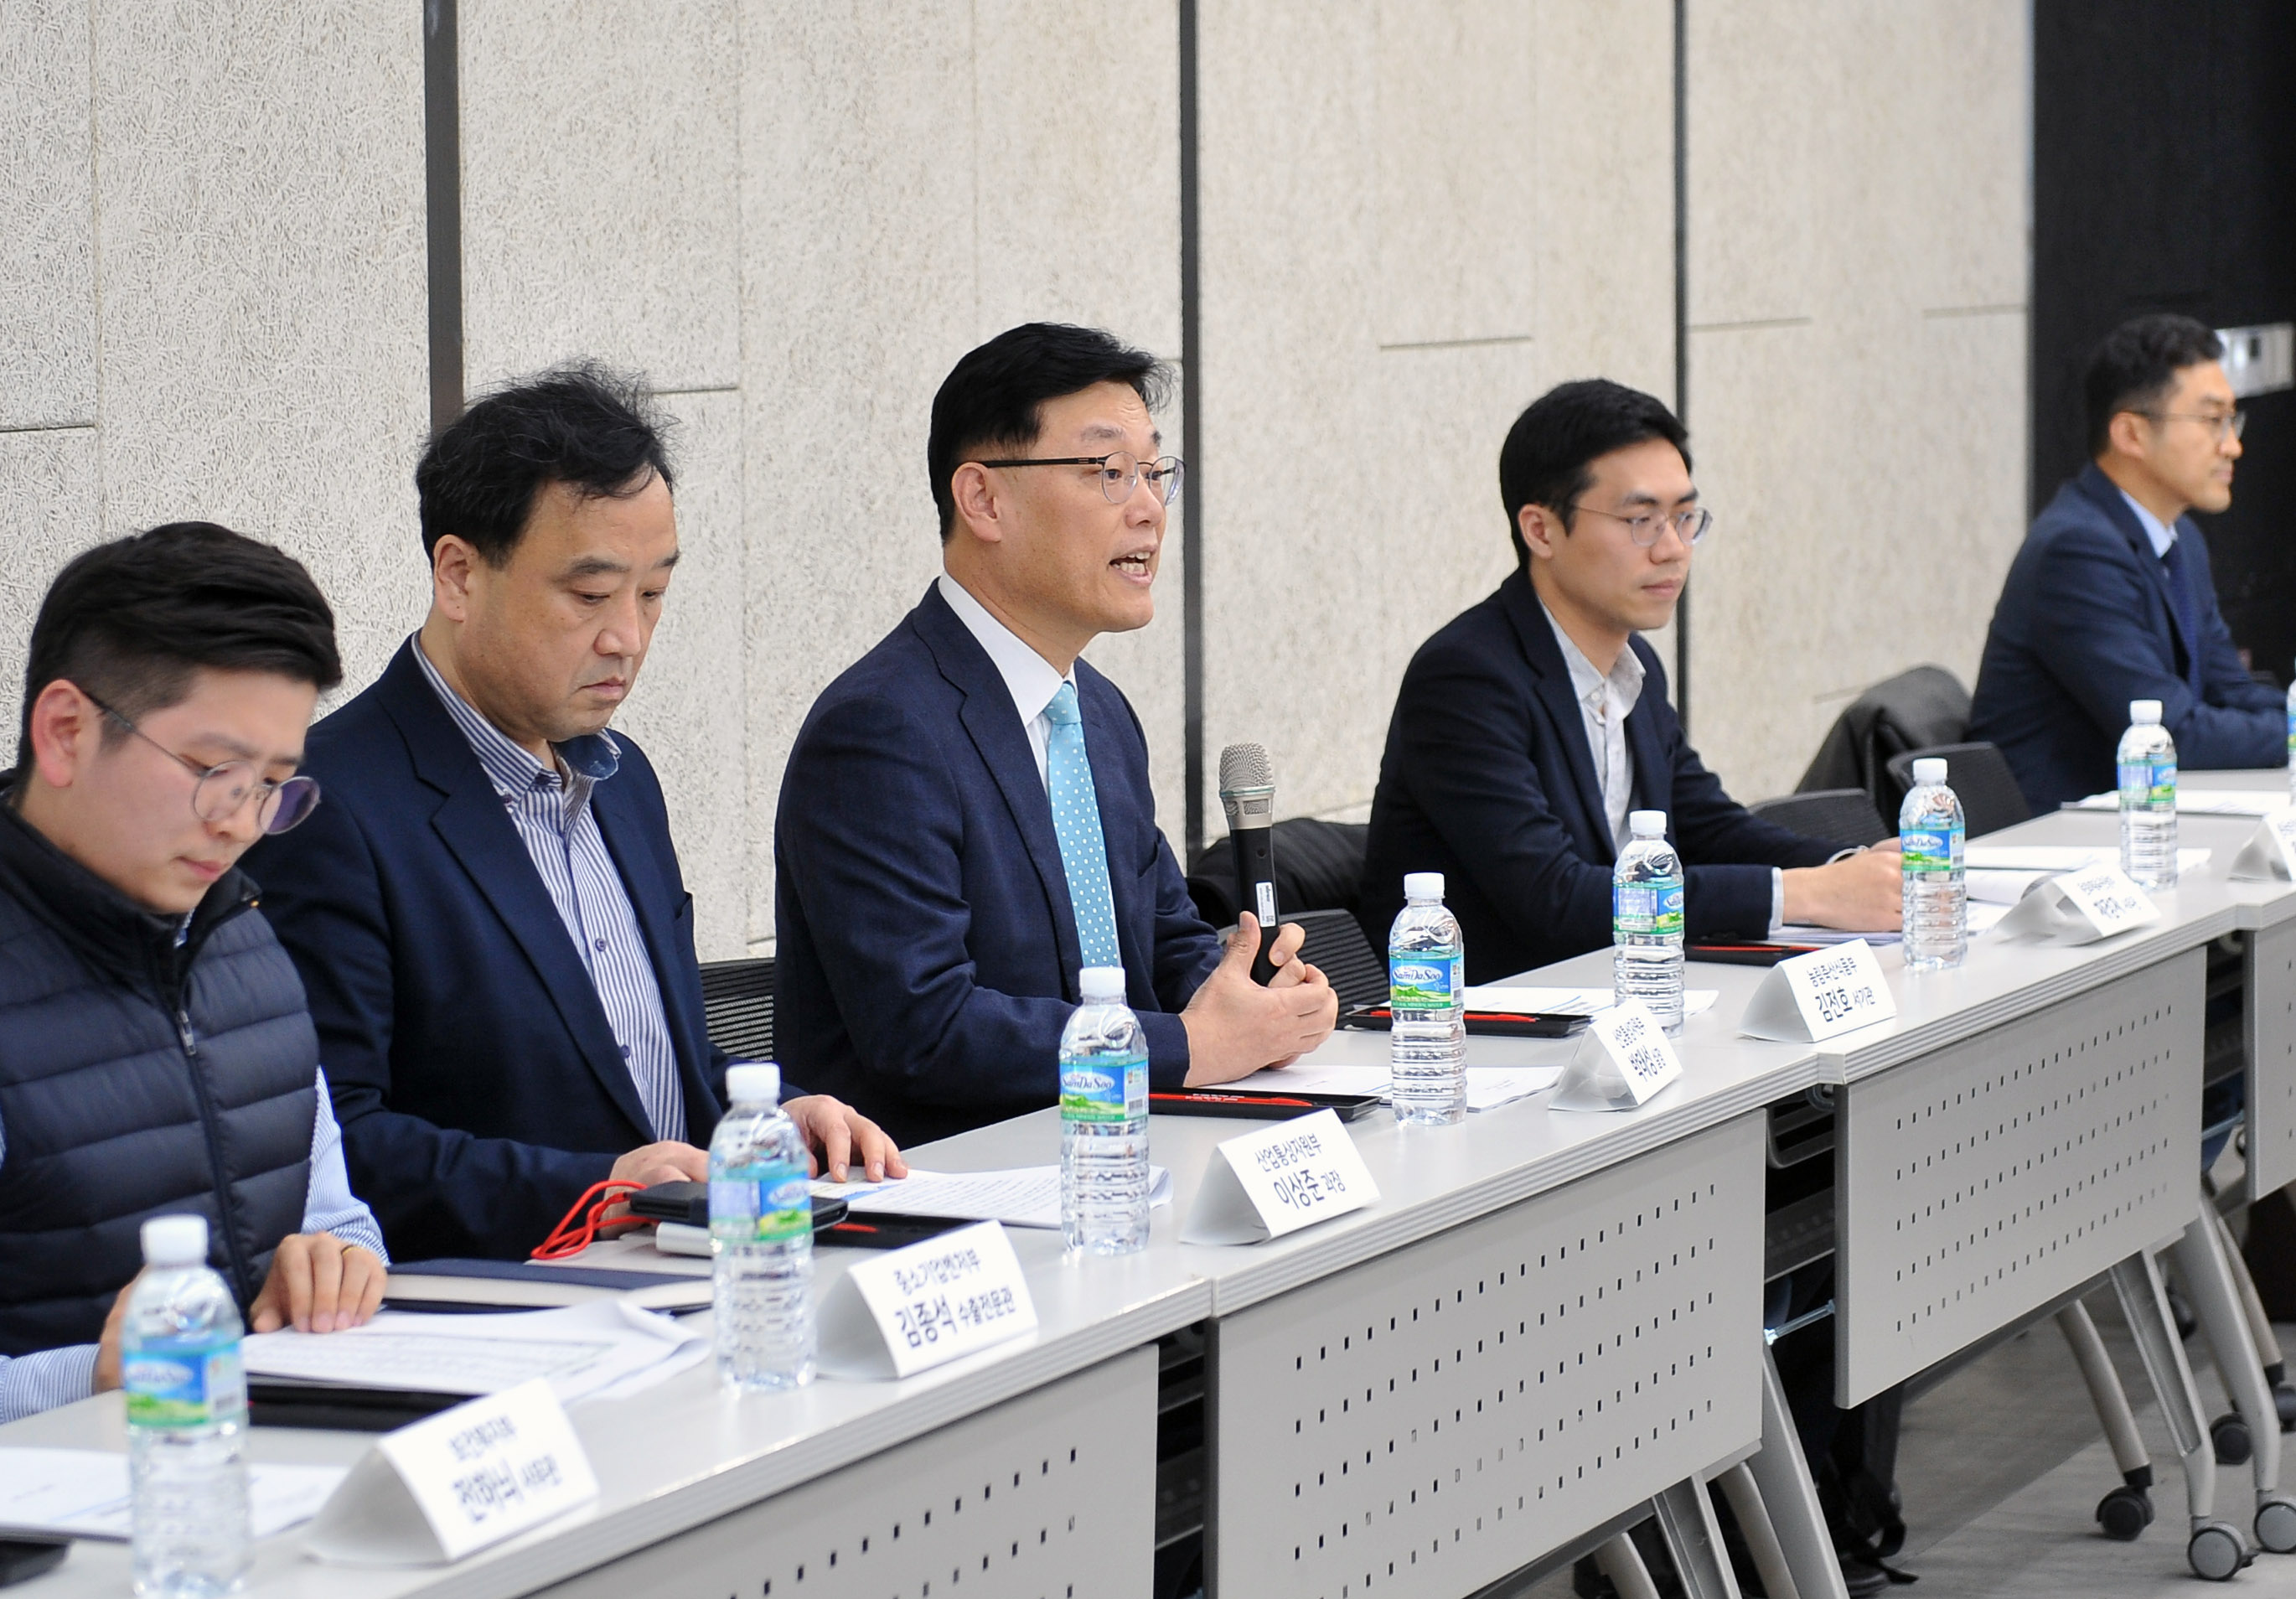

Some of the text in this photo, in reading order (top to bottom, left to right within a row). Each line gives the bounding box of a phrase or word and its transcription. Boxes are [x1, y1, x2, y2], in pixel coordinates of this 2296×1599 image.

[1852, 986, 1875, 1008] 서기관
[1254, 1133, 1321, 1172] 산업통상자원부
[1273, 1169, 1346, 1209] 이상준 과장
[893, 1247, 980, 1296] 중소기업벤처부
[895, 1286, 1016, 1348] 김종석 수출전문관
